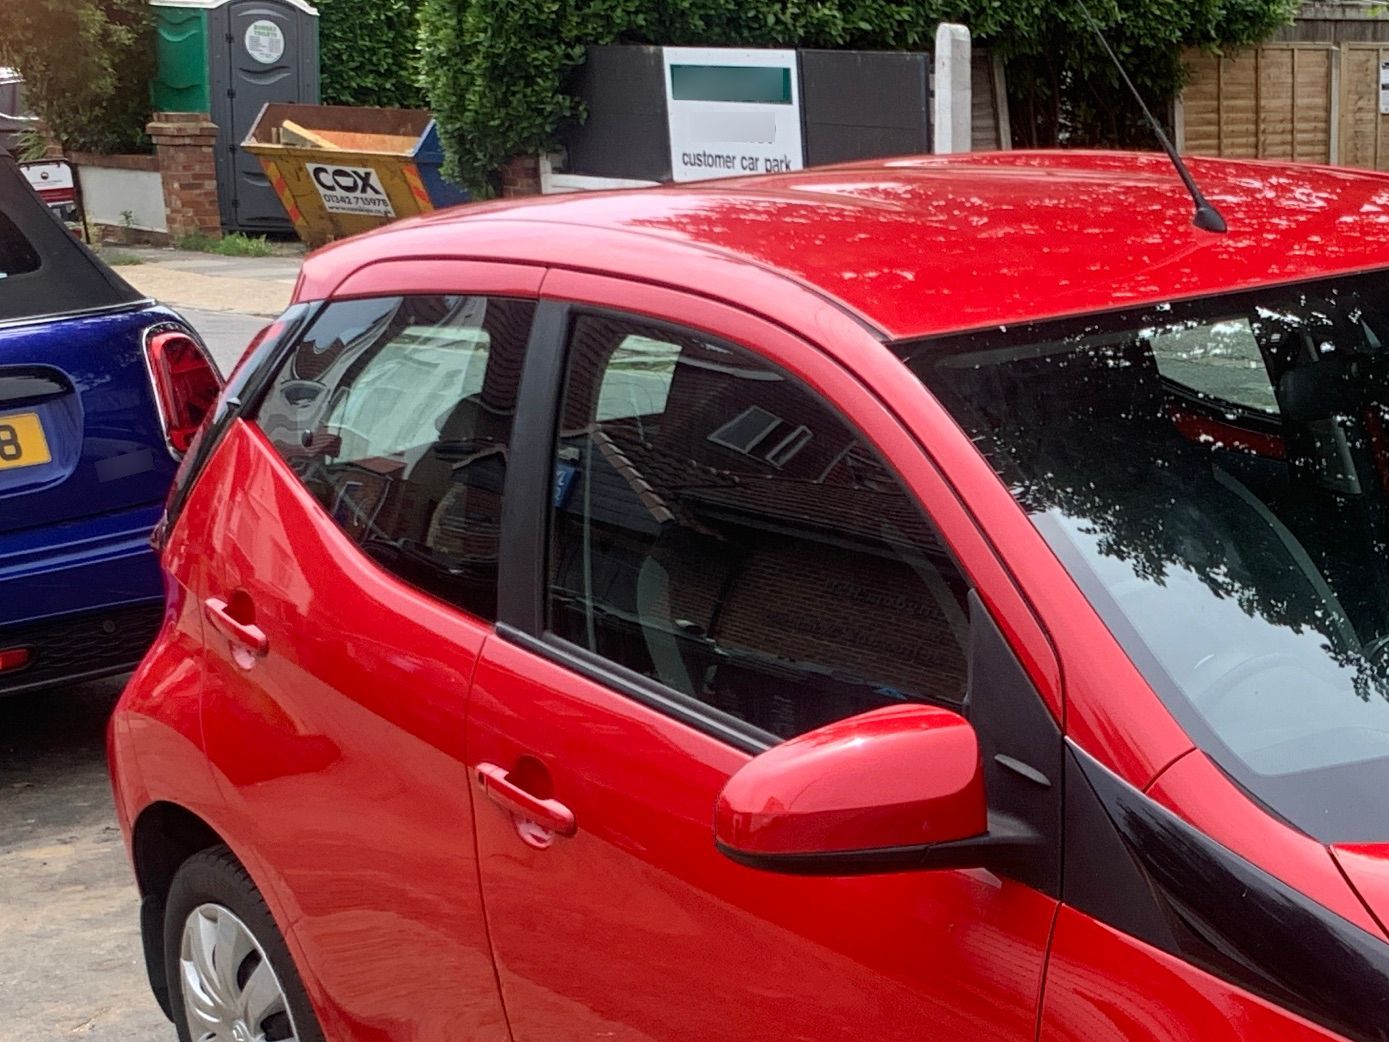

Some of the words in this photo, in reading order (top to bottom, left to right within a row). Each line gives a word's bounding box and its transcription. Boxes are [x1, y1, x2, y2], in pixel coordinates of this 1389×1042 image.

[682, 150, 736, 170] customer
[741, 156, 760, 172] car
[764, 154, 792, 173] park
[313, 167, 383, 195] COX
[323, 194, 353, 205] 01342
